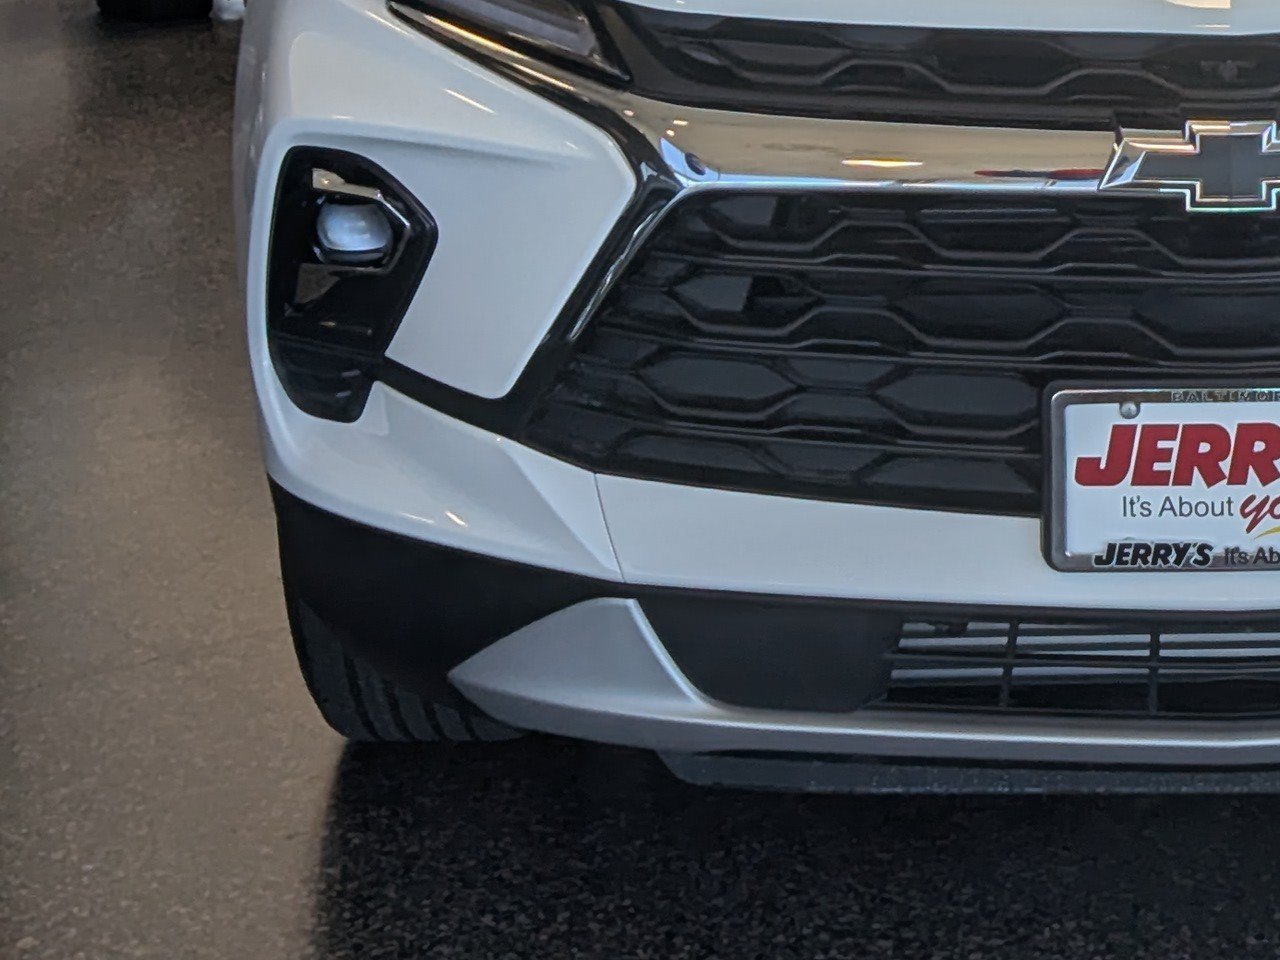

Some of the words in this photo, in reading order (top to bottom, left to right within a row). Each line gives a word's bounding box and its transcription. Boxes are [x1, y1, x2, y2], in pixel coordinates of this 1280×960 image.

[1123, 495, 1152, 518] It's
[1160, 494, 1235, 518] About
[1094, 542, 1214, 567] JERRY'S
[1224, 547, 1249, 564] It's
